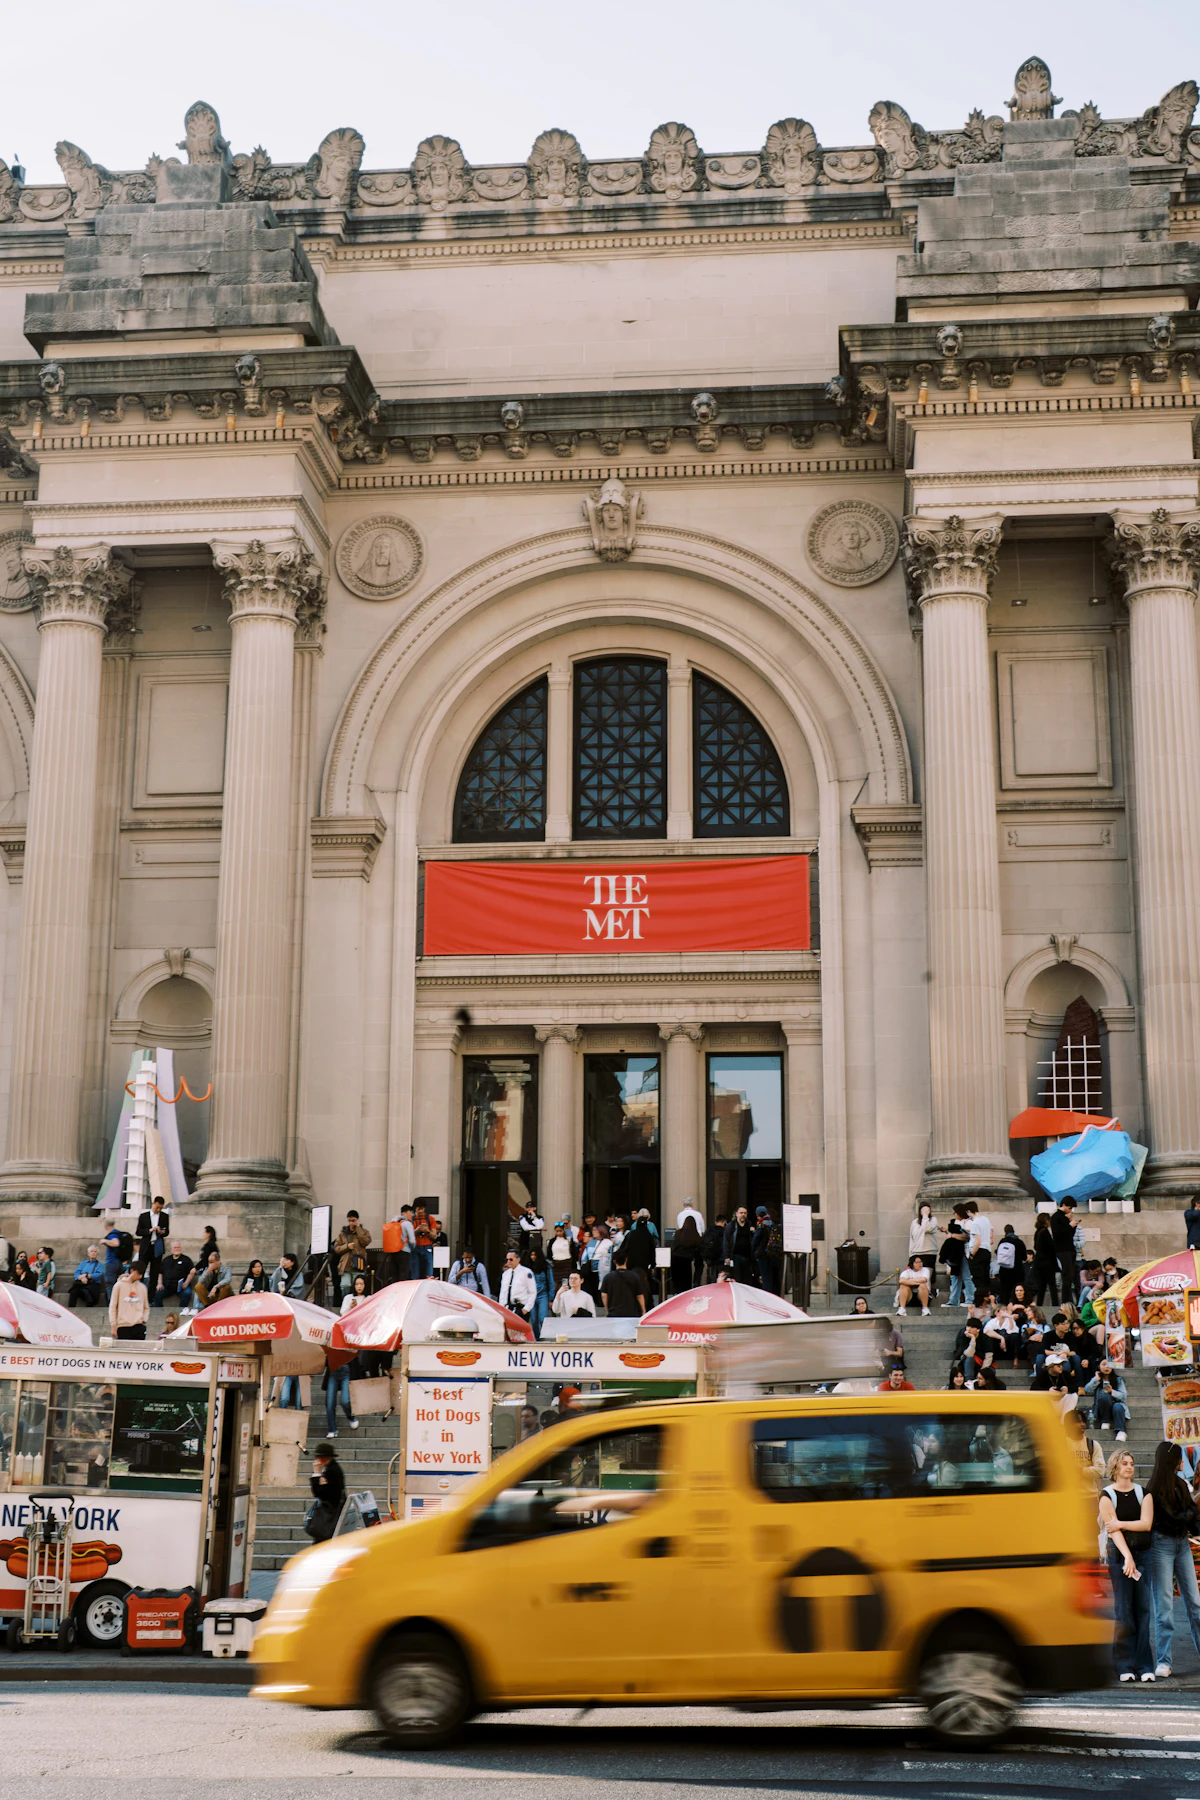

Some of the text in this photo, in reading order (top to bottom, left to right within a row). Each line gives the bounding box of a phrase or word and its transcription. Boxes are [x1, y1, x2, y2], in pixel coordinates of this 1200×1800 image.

[583, 874, 649, 905] THE
[582, 908, 650, 940] MET
[1148, 1275, 1183, 1289] NIKAS
[210, 1323, 277, 1337] COLD DRINKS
[309, 1327, 325, 1339] HOT
[668, 1332, 682, 1341] LD
[37, 1333, 74, 1344] HOT DOGS
[1, 1356, 164, 1371] E BEST HOT DOGS IN NEW YORK
[508, 1351, 594, 1368] NEW YORK
[227, 1363, 244, 1378] WATER
[433, 1388, 464, 1401] Best
[416, 1409, 481, 1425] Hot Dogs
[441, 1429, 454, 1443] in
[413, 1451, 482, 1464] New York
